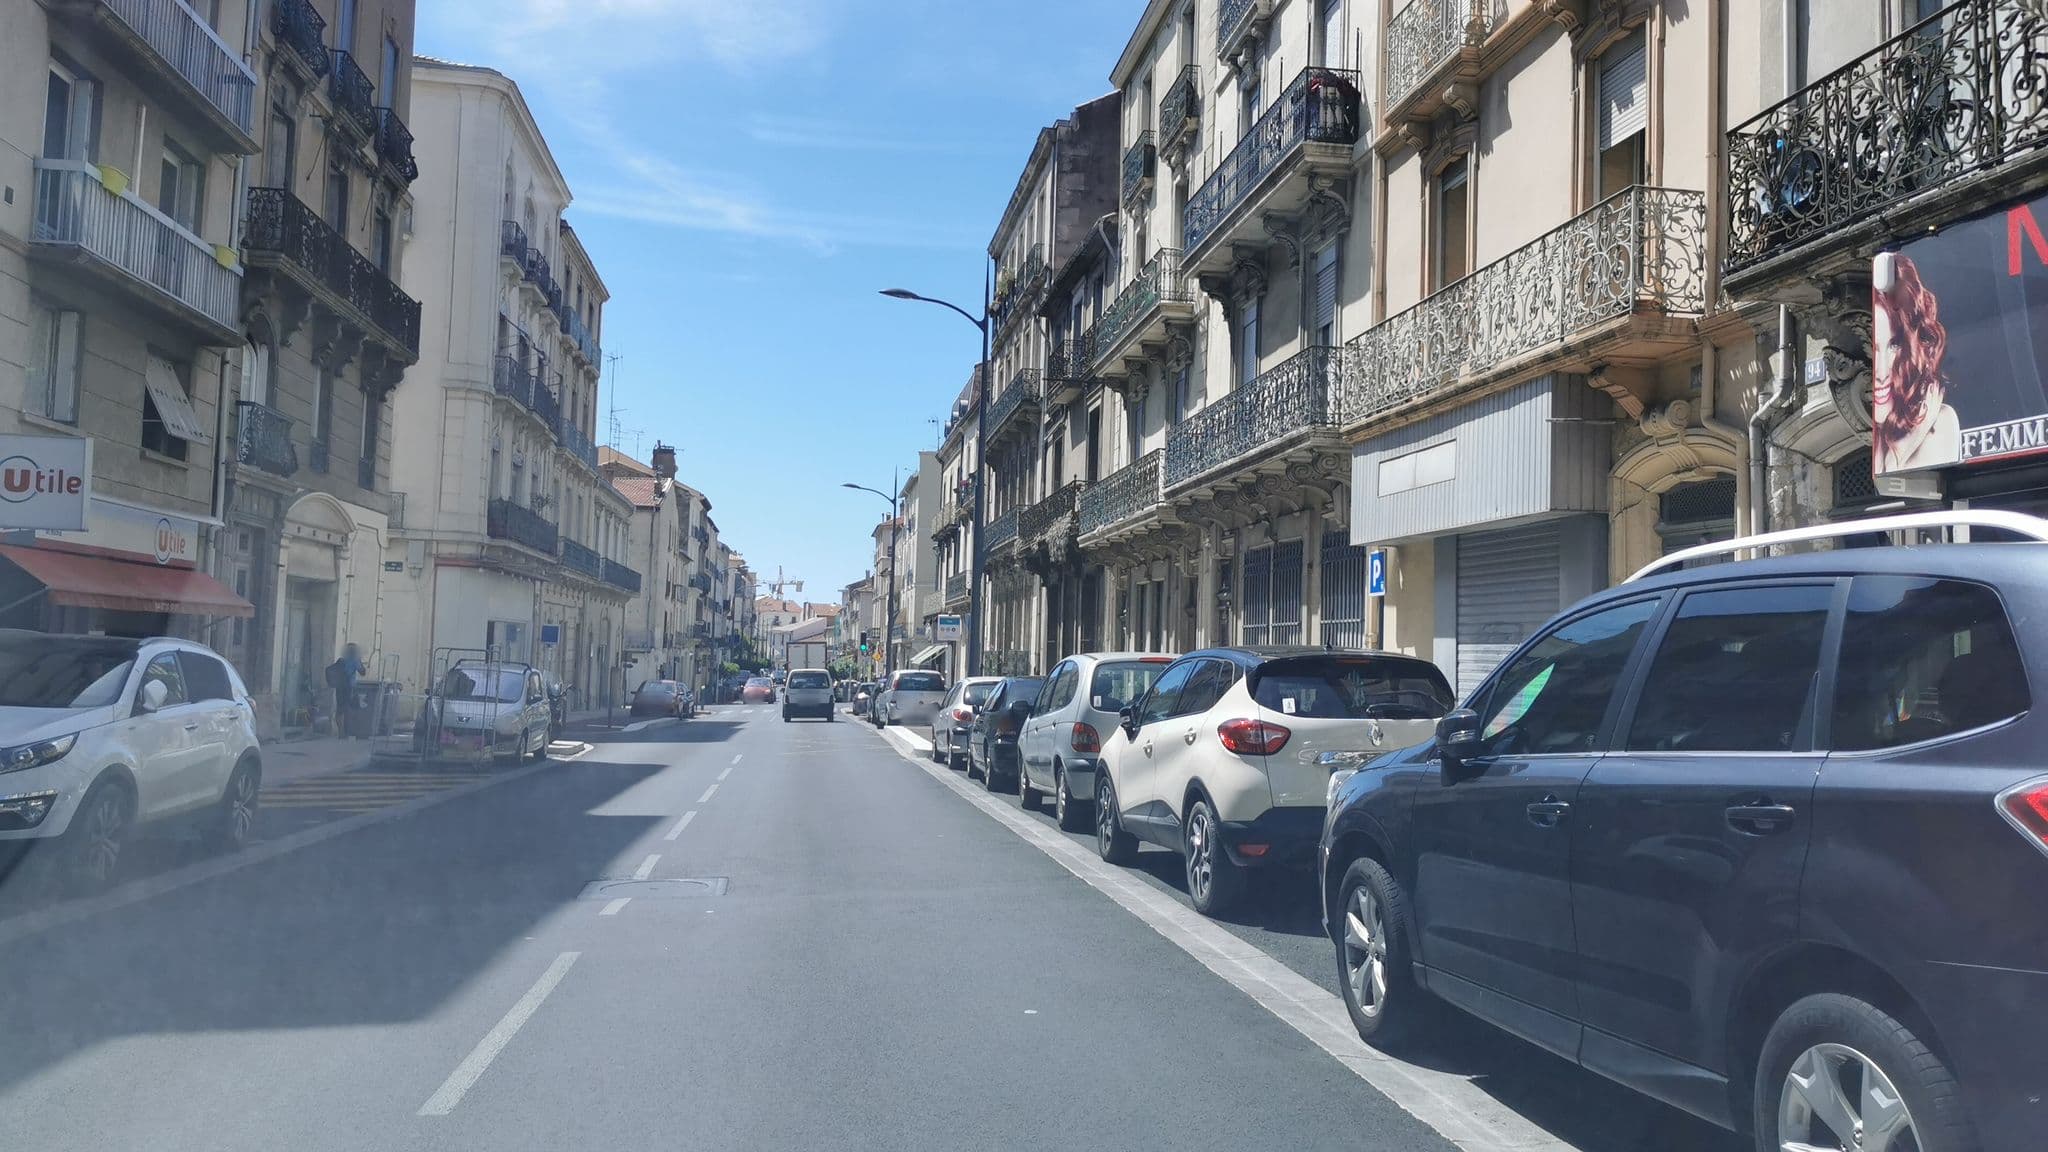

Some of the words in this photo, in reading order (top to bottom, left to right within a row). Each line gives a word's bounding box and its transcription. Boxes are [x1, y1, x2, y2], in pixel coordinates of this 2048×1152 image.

[1807, 361, 1821, 379] 94
[1962, 418, 2048, 457] FEMM
[4, 468, 82, 494] Utile
[158, 529, 186, 554] Utile
[1373, 559, 1381, 587] P
